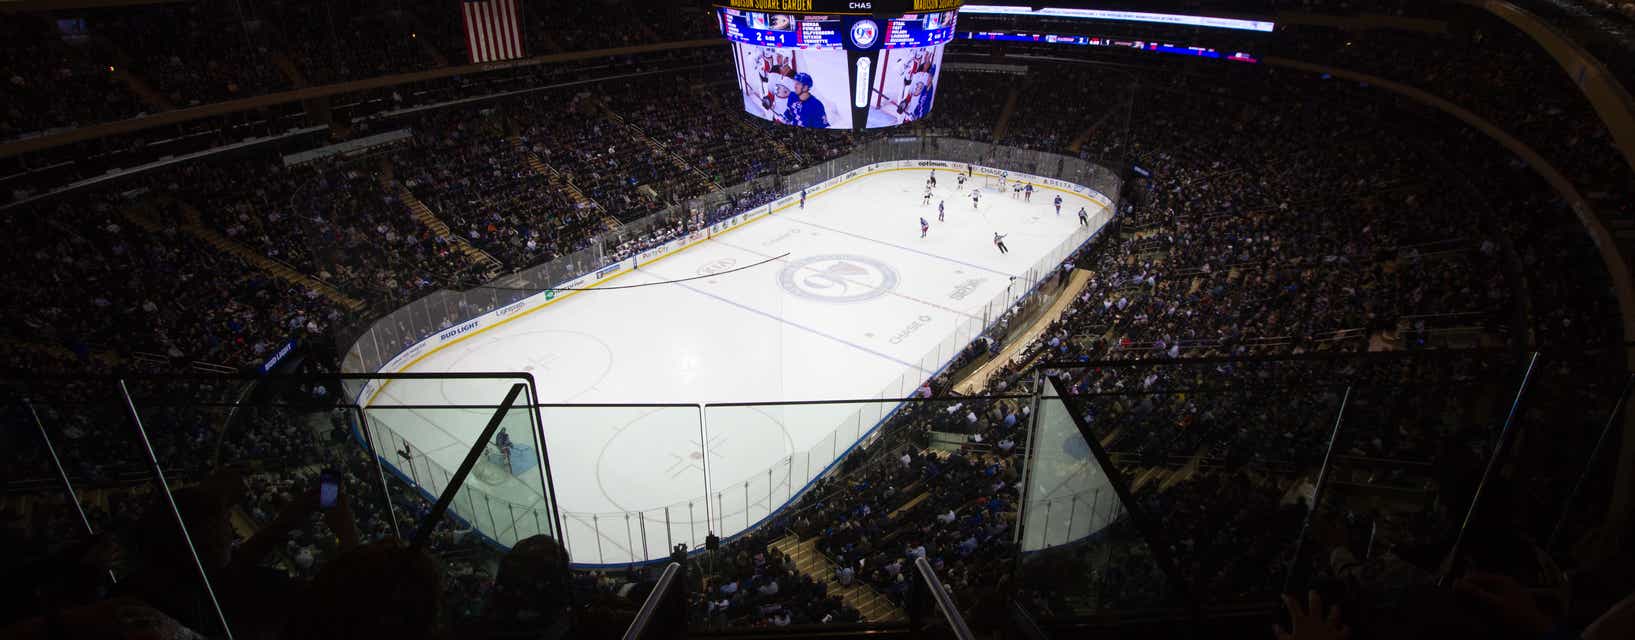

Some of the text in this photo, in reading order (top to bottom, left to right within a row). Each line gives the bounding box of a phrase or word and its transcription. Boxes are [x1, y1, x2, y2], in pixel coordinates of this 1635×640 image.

[755, 0, 781, 9] SQUARE
[782, 0, 813, 11] GARDEN
[756, 32, 762, 42] 2
[779, 34, 785, 44] 1
[927, 33, 933, 42] 2
[981, 167, 1001, 176] CHASE
[1050, 179, 1072, 189] DELTA
[440, 321, 479, 341] BUD LIGHT
[889, 320, 923, 345] CHASE
[264, 343, 292, 371] BUD LIGHT
